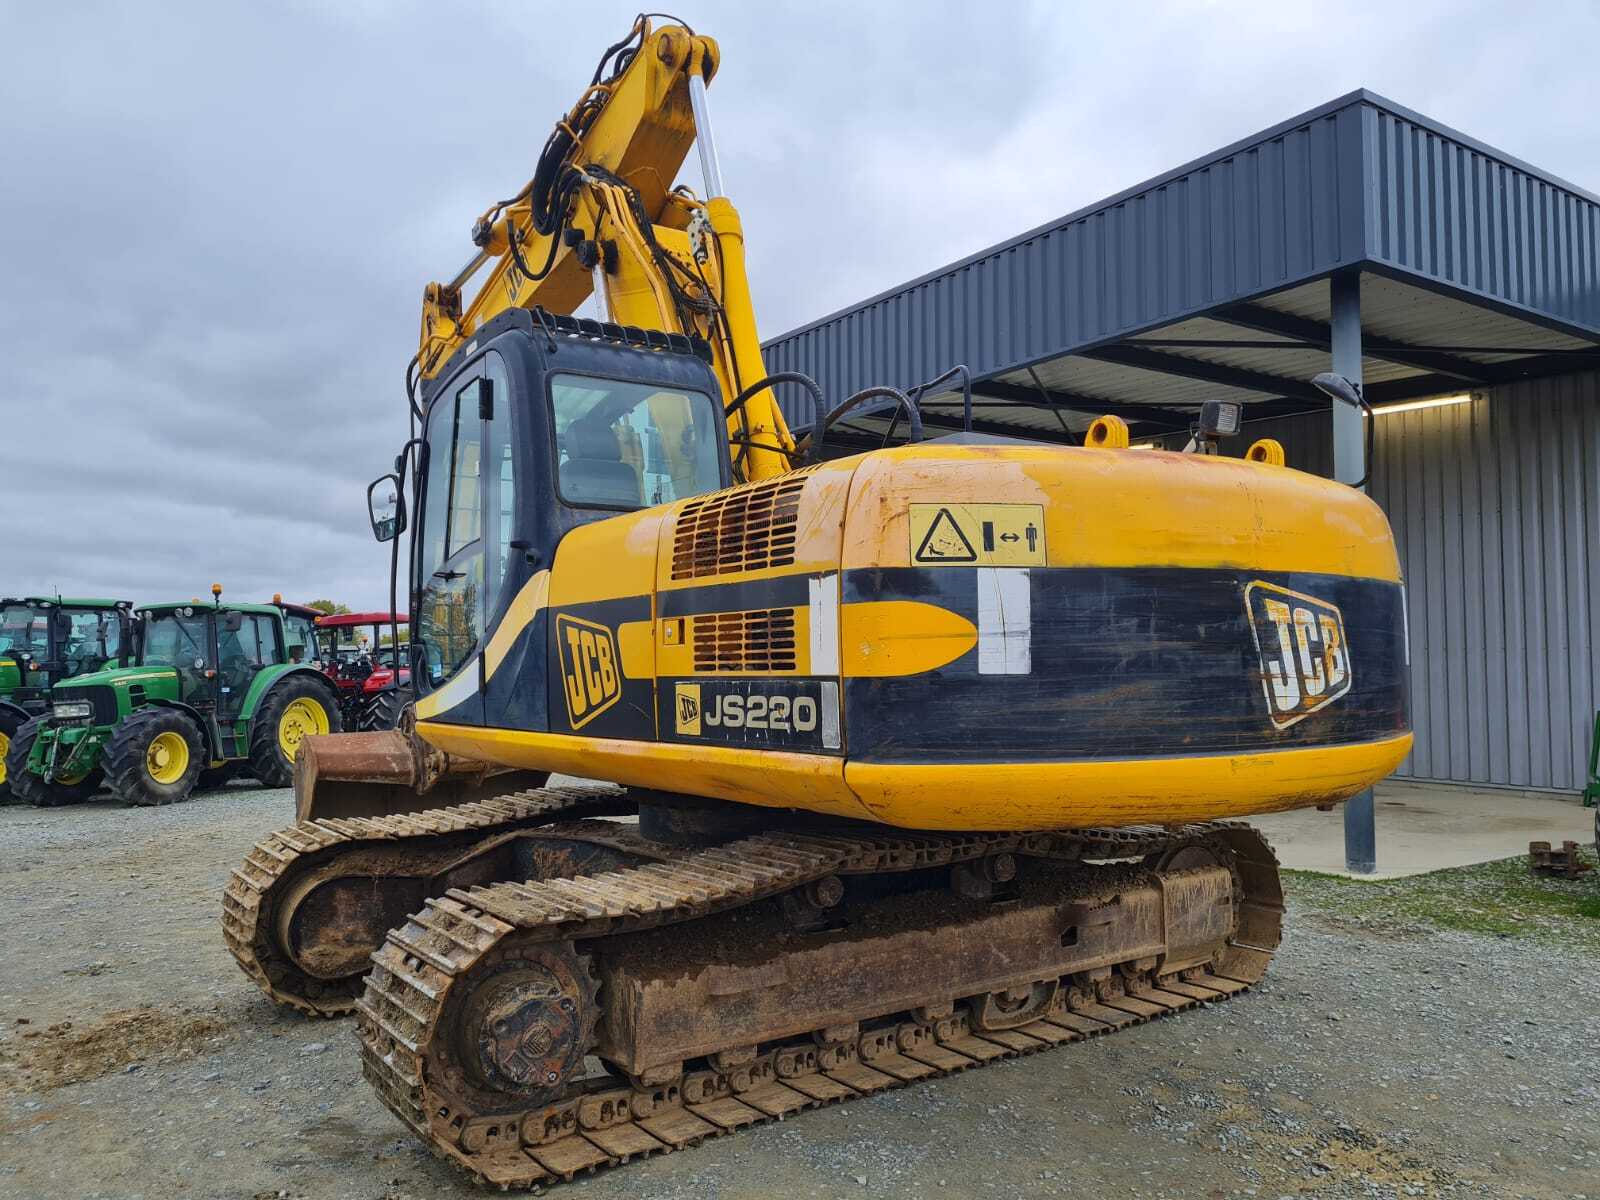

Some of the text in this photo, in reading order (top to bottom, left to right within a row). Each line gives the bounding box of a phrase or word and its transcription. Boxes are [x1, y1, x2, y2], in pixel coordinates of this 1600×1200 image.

[566, 625, 616, 716] JCB
[1264, 598, 1345, 711] JCB
[680, 695, 817, 732] JCB JS220
